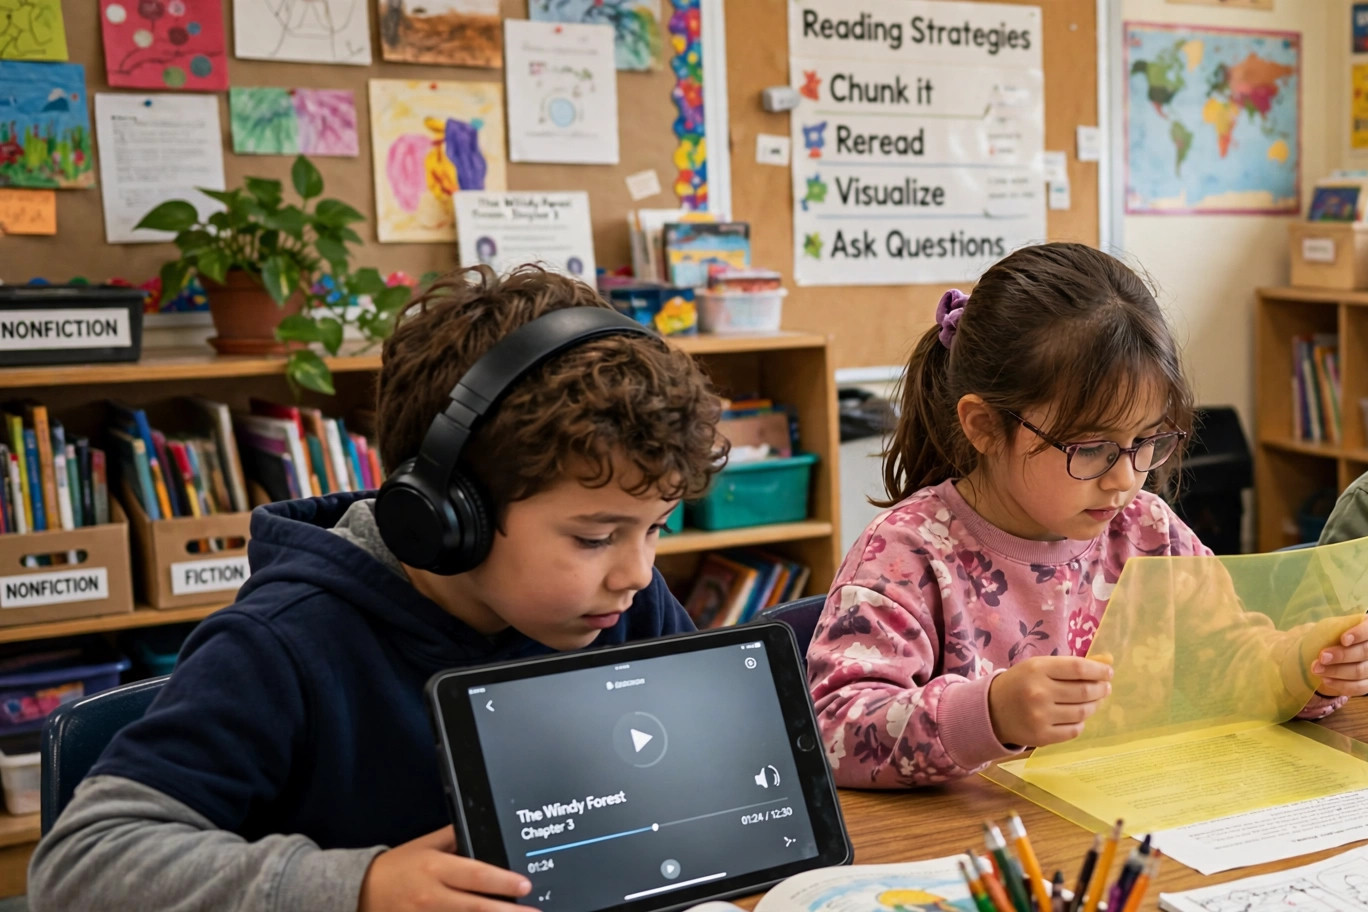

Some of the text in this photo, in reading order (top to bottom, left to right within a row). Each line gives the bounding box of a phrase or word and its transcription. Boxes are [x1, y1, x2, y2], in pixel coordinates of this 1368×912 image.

[802, 9, 1031, 55] Reading Strategies
[830, 73, 934, 105] Chunk it
[836, 125, 925, 155] Reread
[835, 176, 945, 206] Visualize
[830, 229, 1005, 259] Ask Questions
[1, 318, 118, 339] NONFICTION
[6, 576, 99, 599] NONFICTION
[185, 565, 244, 585] FICTION
[516, 791, 627, 823] The Windy Forest
[741, 813, 764, 825] 01:24
[771, 807, 793, 819] 12:30
[521, 819, 575, 839] Chapter 3
[527, 859, 554, 873] 01:24
